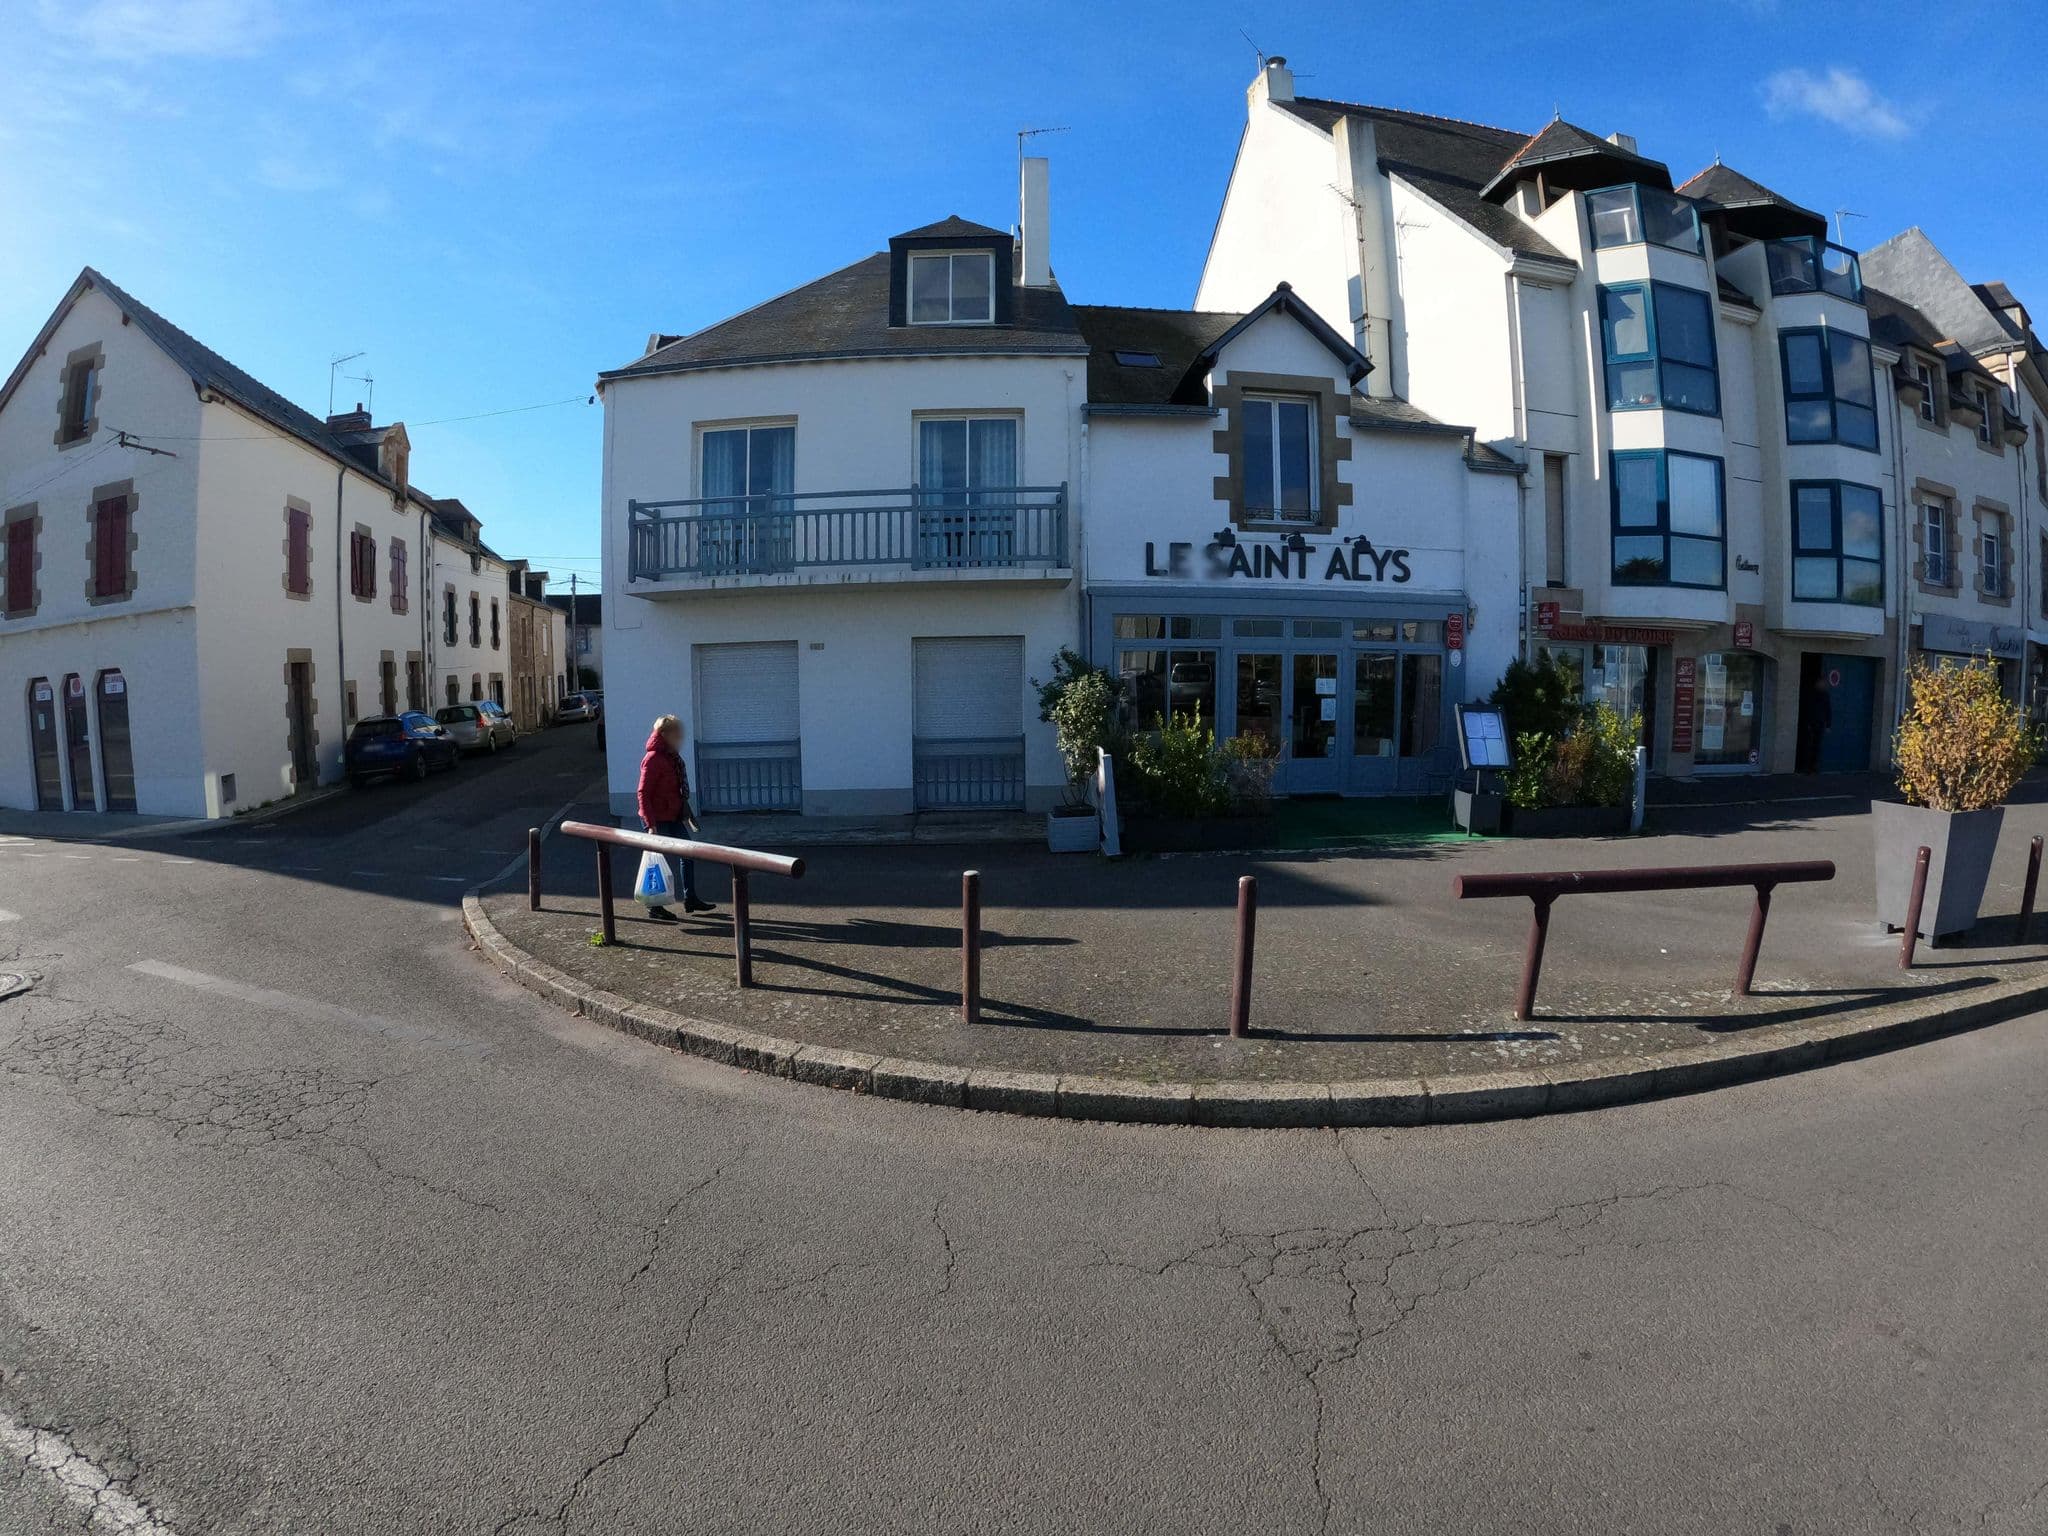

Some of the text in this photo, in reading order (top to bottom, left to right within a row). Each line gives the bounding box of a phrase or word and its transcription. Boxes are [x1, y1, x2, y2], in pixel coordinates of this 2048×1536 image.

[1146, 542, 1411, 583] LE SAINT ALYS
